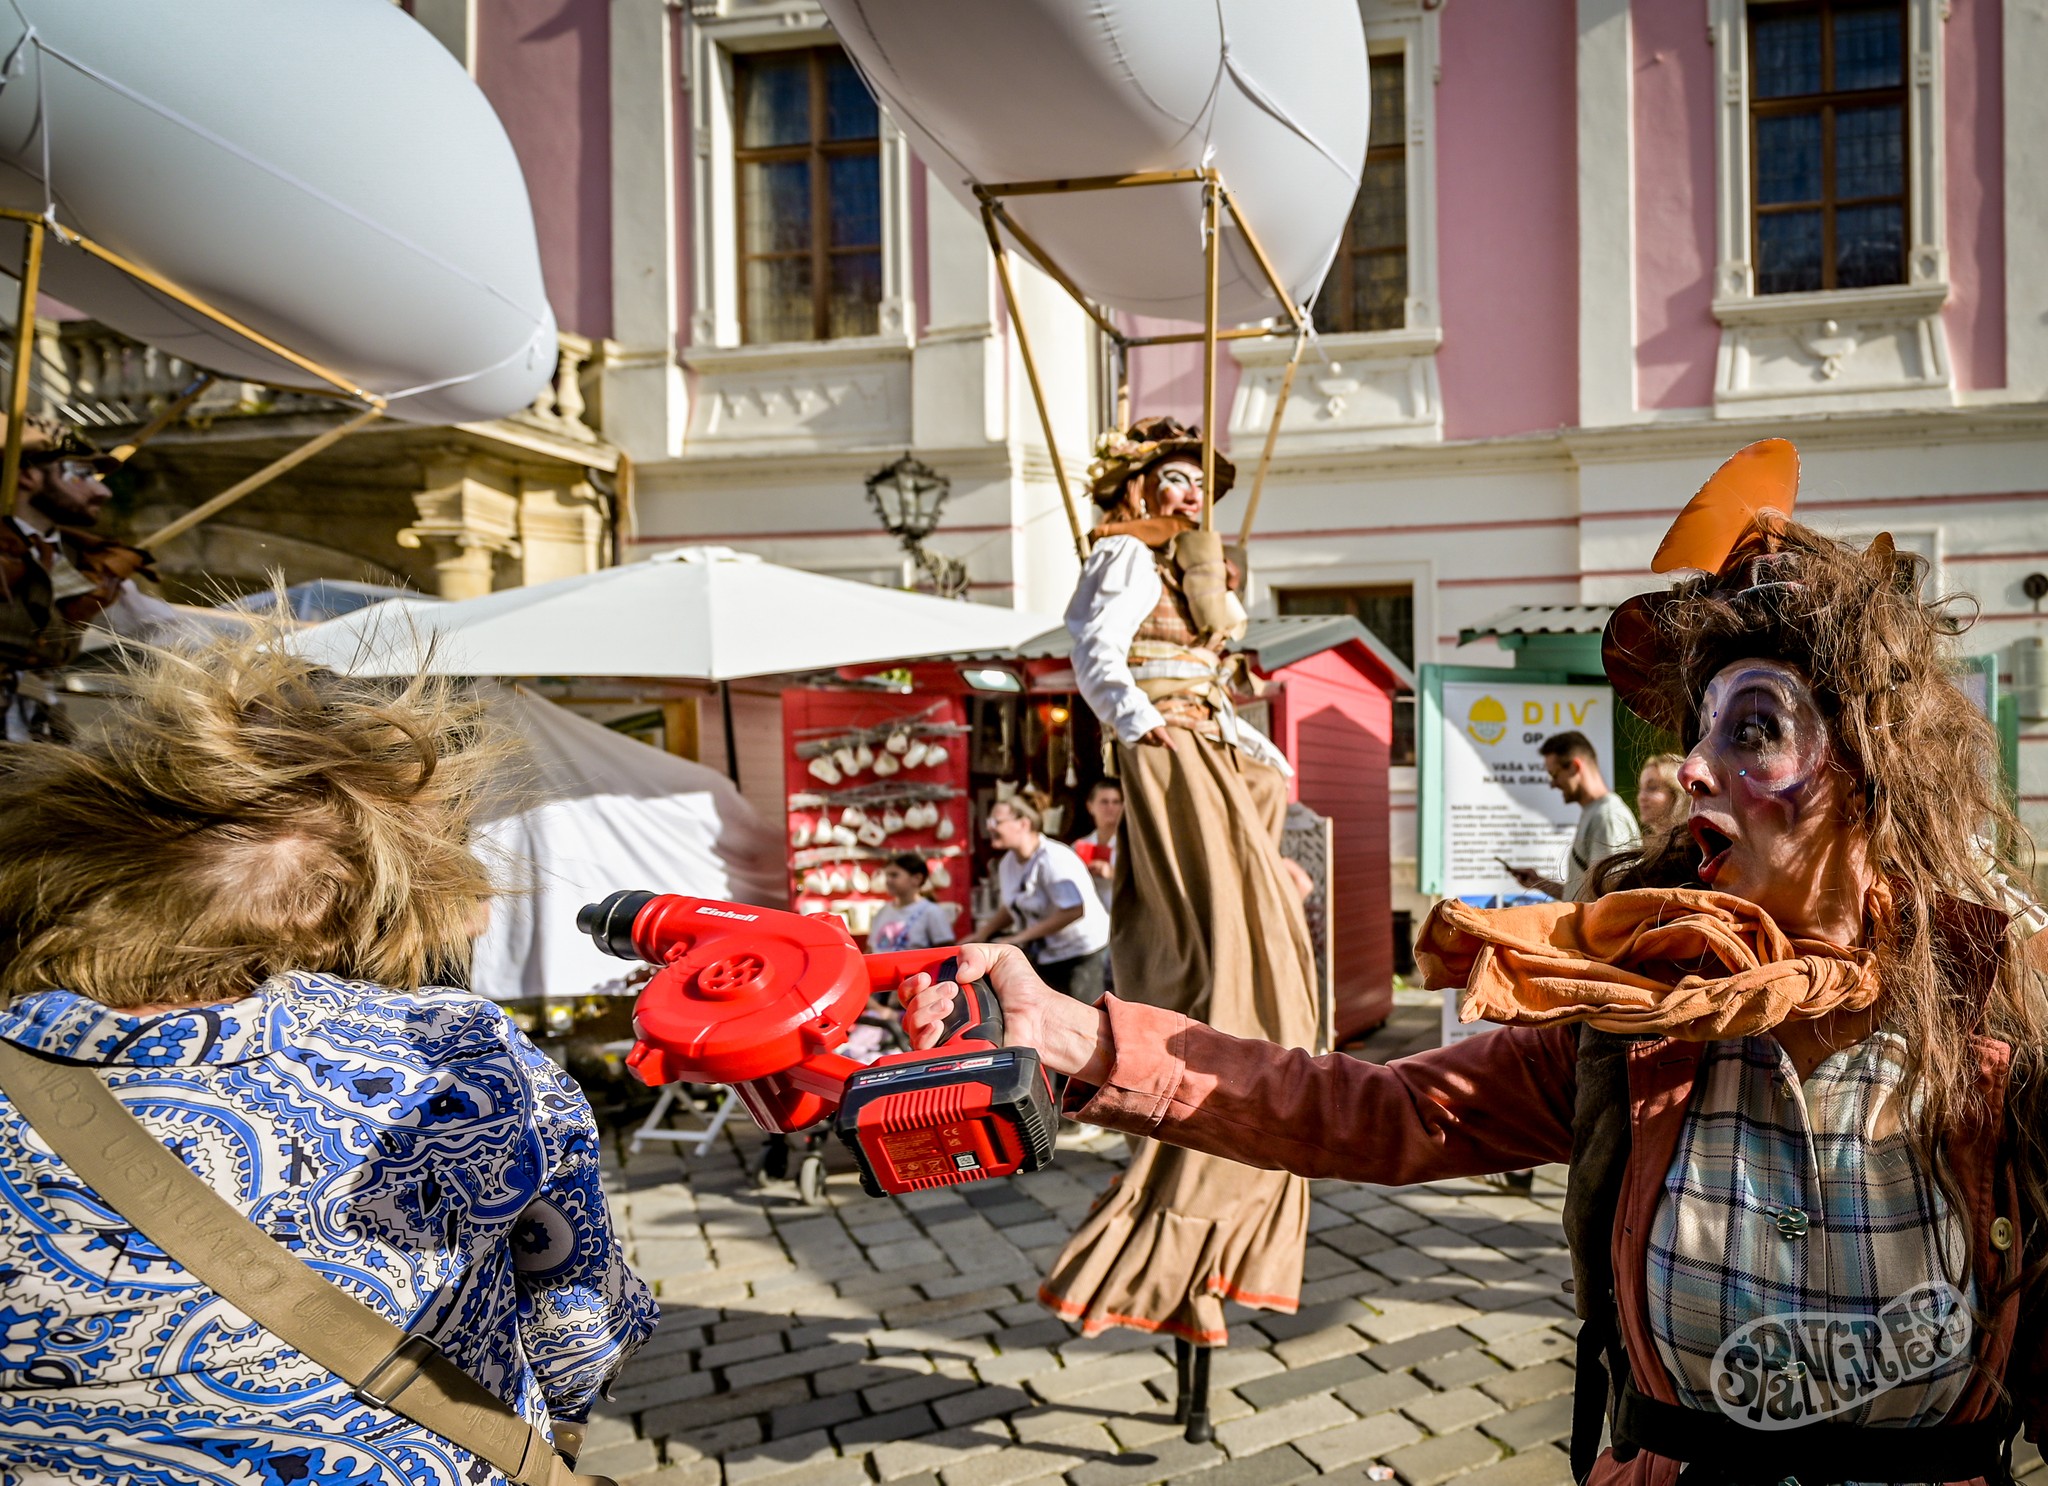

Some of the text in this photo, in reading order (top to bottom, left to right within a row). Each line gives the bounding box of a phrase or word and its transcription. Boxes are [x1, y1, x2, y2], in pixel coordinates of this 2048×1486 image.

[1523, 699, 1597, 726] DIV
[1492, 761, 1523, 772] VAŠA
[695, 906, 760, 922] Einhell
